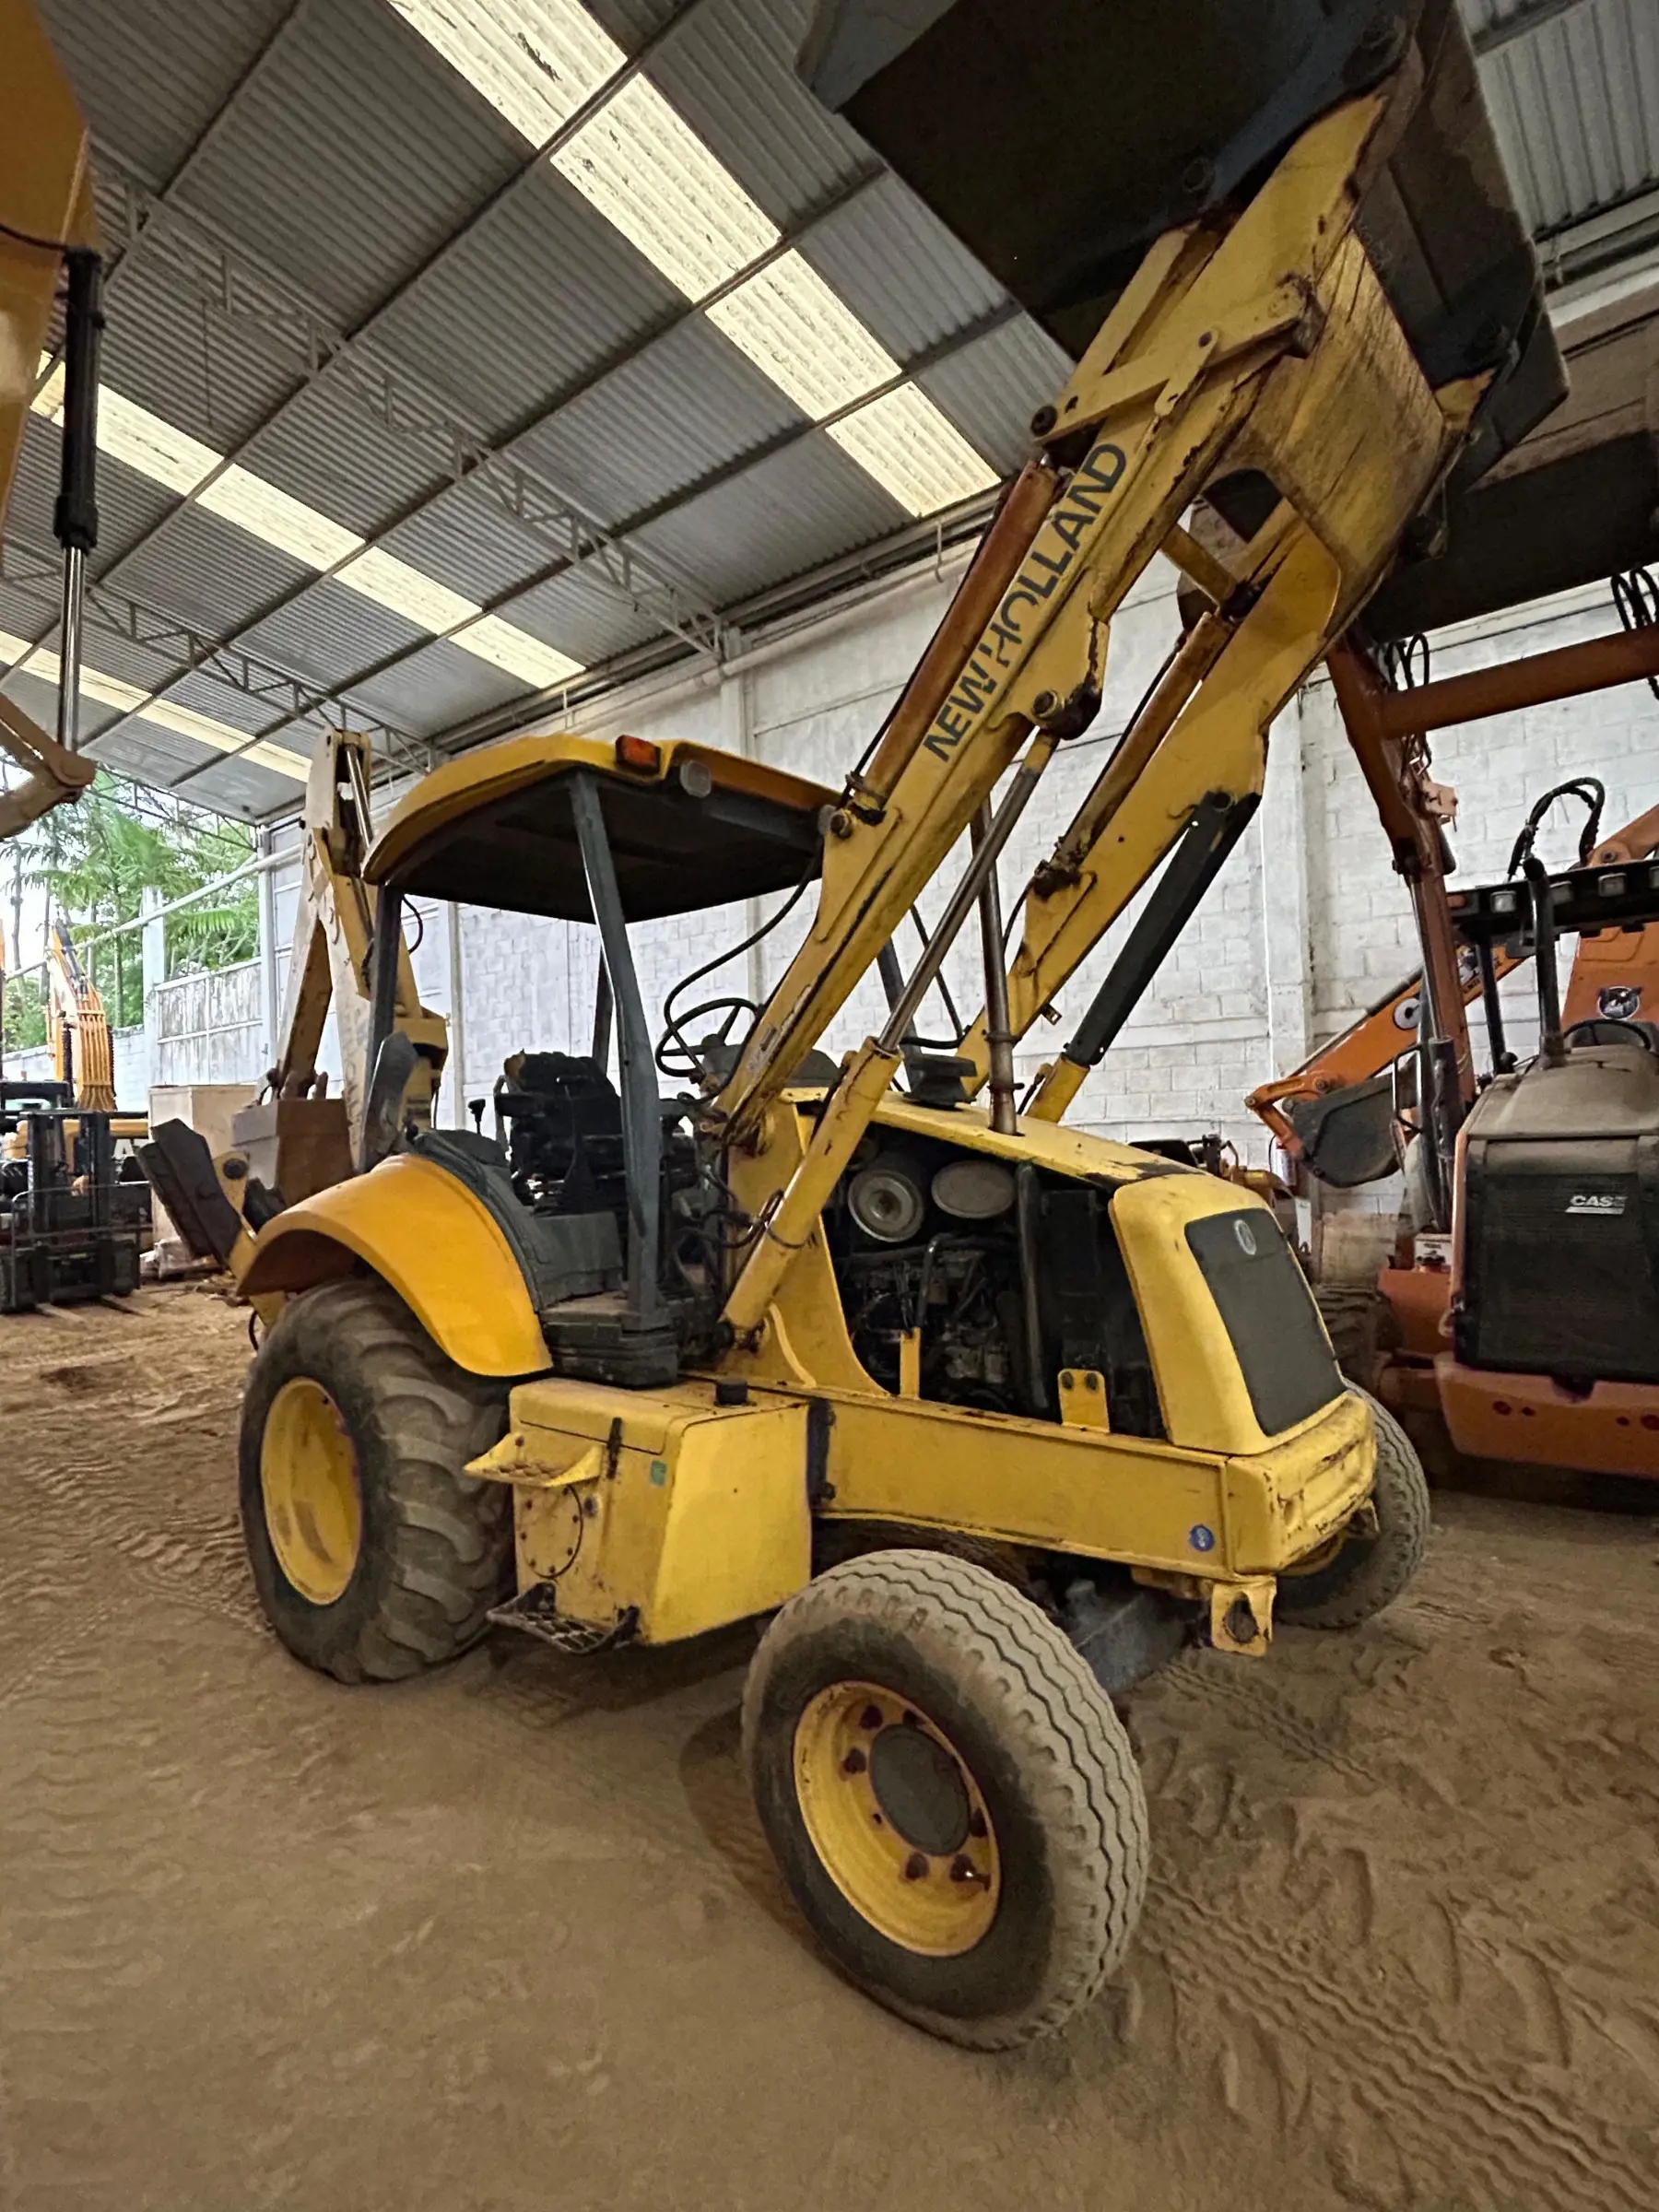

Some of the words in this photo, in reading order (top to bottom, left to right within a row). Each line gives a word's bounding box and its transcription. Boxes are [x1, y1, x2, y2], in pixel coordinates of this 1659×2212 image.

[924, 659, 997, 763] NEW
[978, 443, 1127, 668] HOLLAND
[1570, 1194, 1629, 1207] CASE
